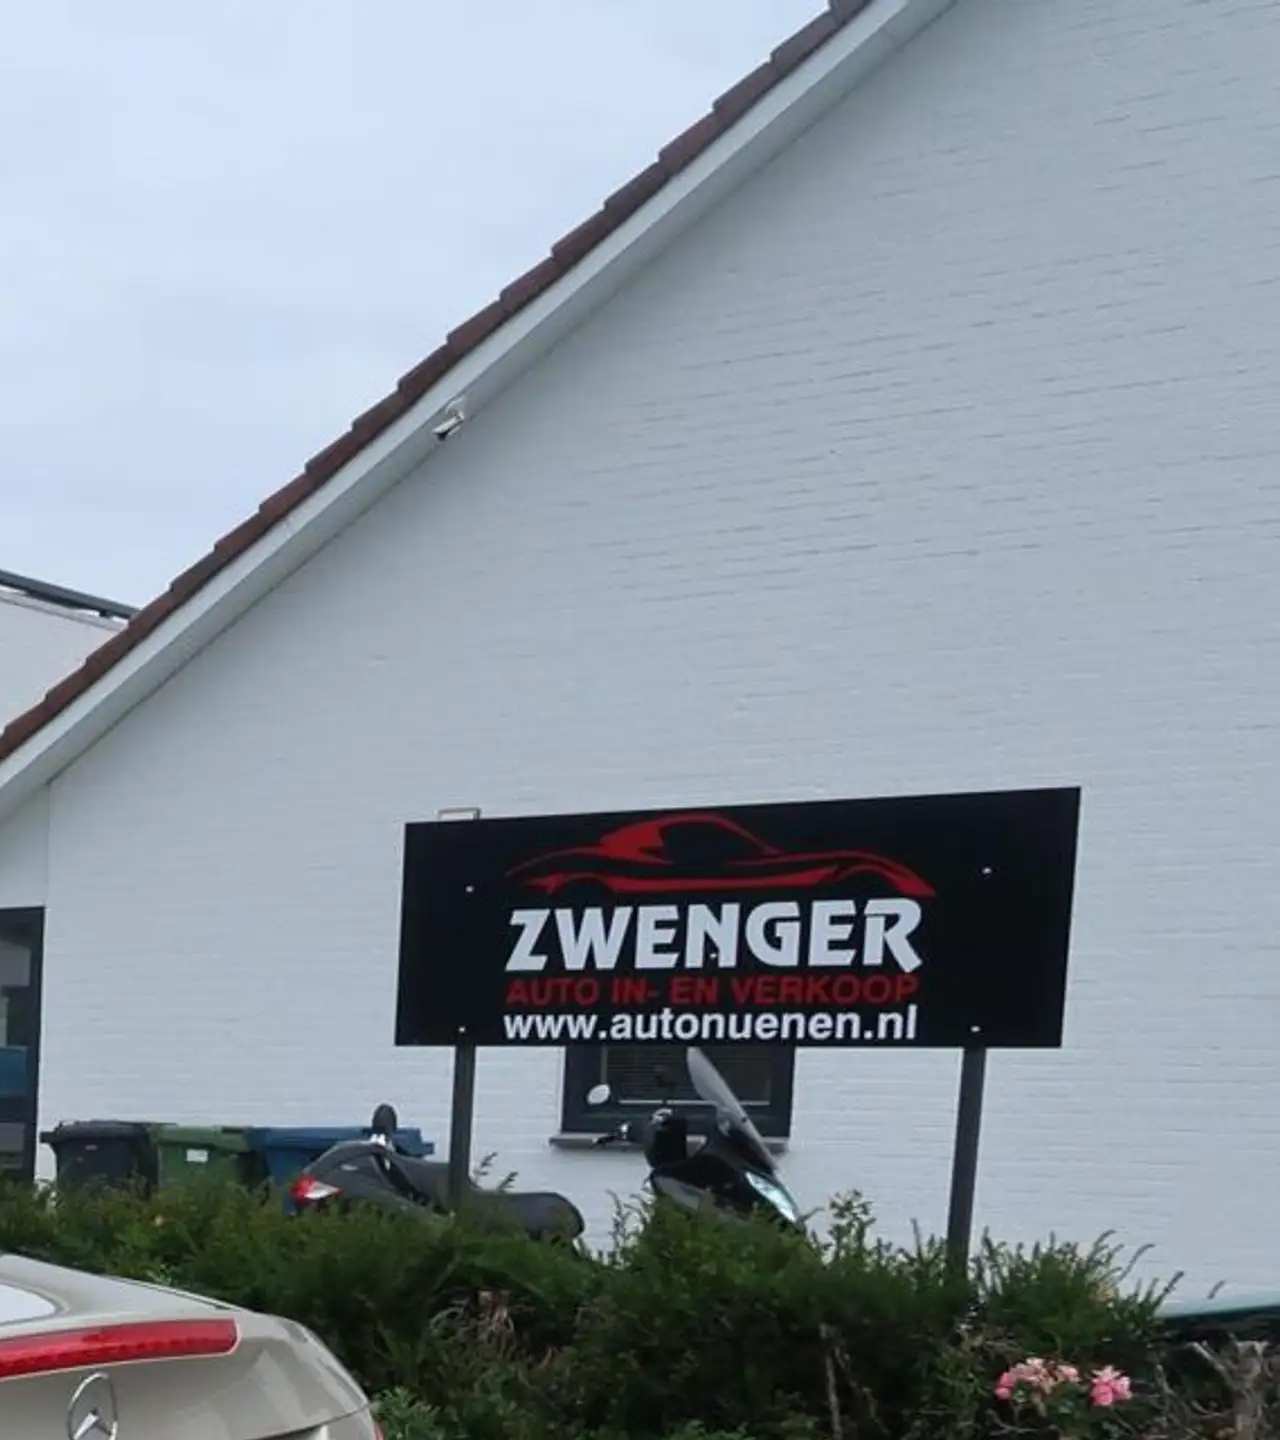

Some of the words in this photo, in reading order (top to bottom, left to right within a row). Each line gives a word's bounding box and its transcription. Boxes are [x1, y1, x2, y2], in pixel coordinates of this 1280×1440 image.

[504, 897, 923, 973] ZWENGER
[505, 976, 598, 1007] AUTO
[611, 977, 660, 1005] IN-
[669, 976, 719, 1005] EN
[730, 973, 921, 1005] VERKOOP
[503, 1004, 918, 1040] www.autonuenen.nl
